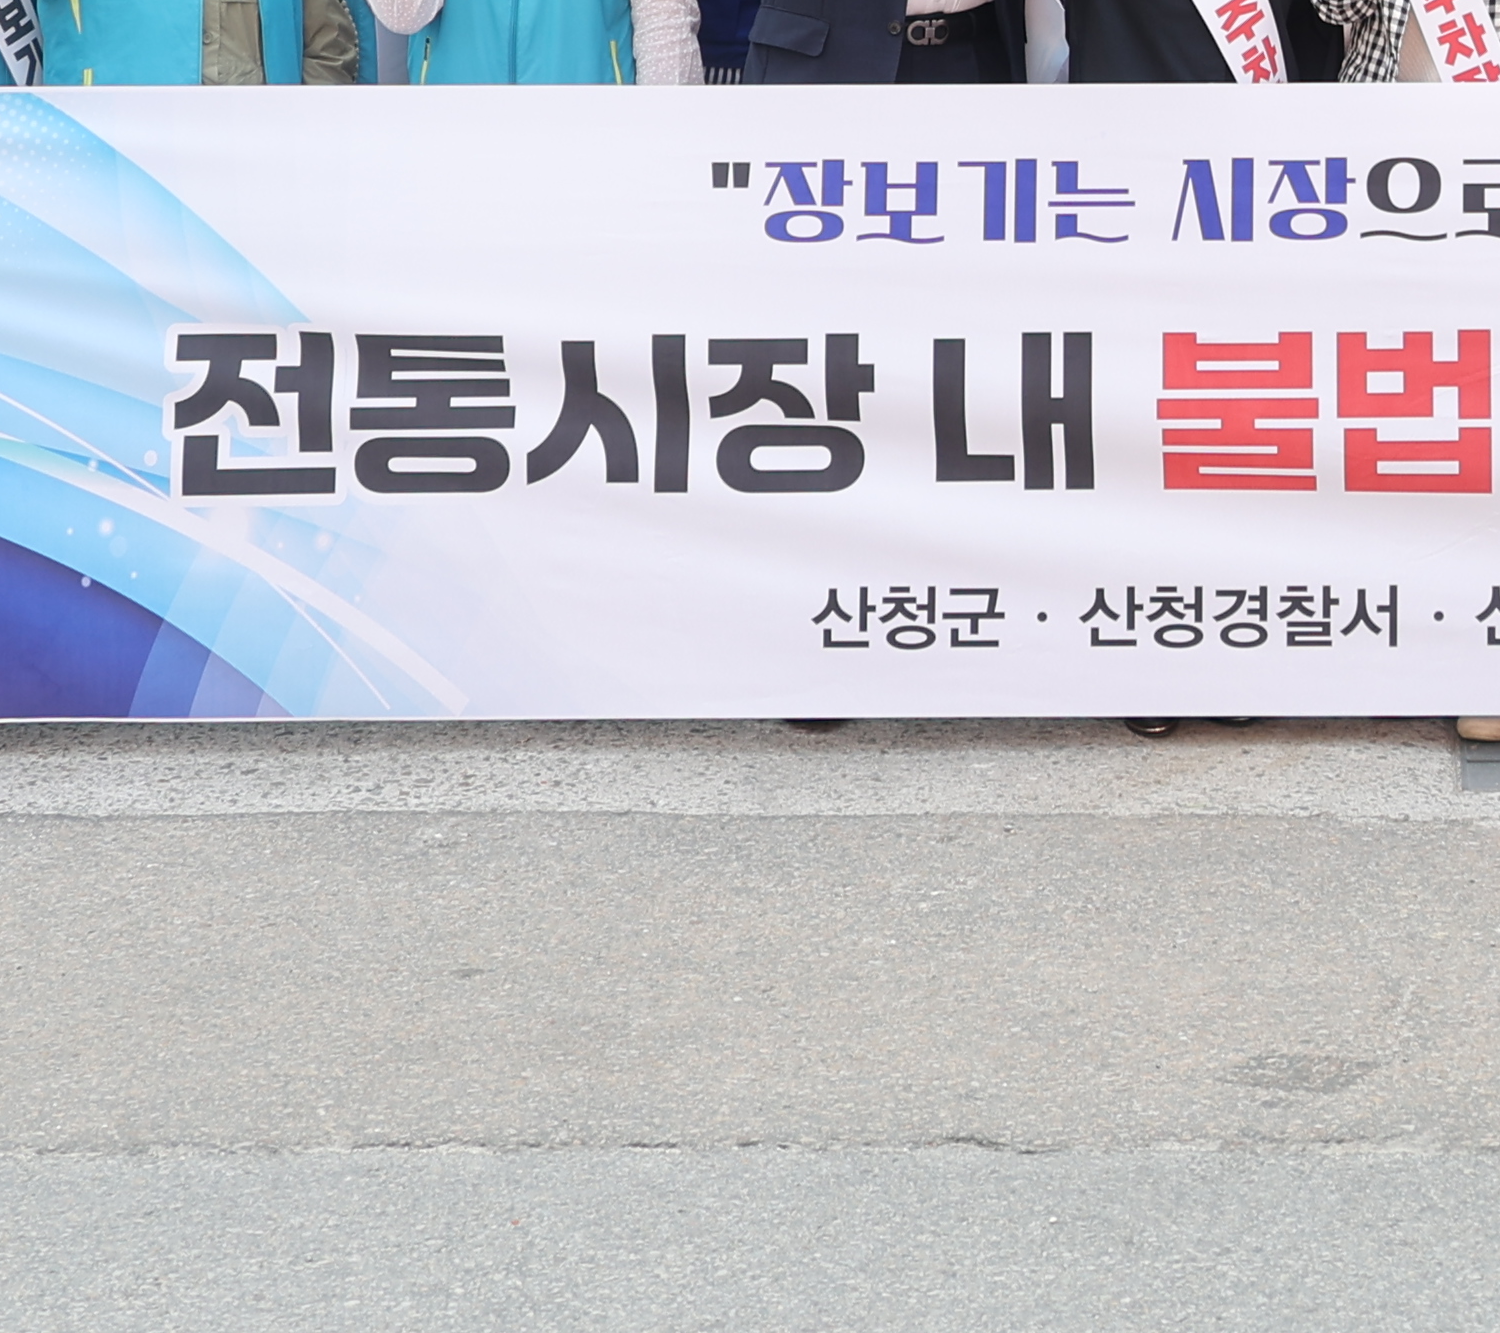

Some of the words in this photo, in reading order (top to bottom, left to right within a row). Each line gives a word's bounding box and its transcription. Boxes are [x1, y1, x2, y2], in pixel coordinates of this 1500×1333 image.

[709, 158, 1135, 246] "장보기는
[171, 329, 875, 497] 전통시장
[933, 329, 1096, 492] 내
[1156, 329, 1492, 495] 불법
[811, 585, 1005, 650] 산청군
[1078, 583, 1402, 650] 산청경찰서
